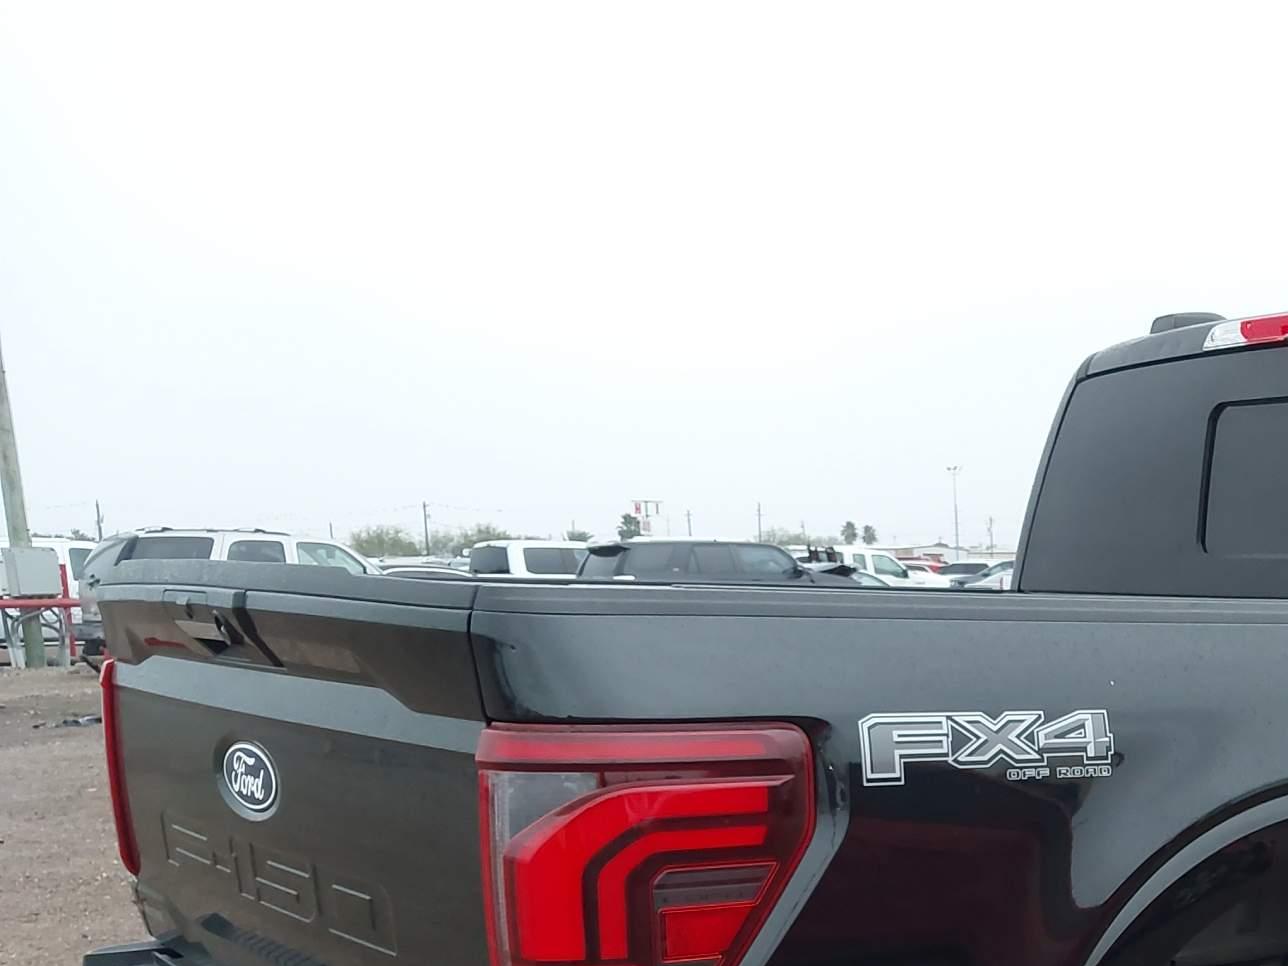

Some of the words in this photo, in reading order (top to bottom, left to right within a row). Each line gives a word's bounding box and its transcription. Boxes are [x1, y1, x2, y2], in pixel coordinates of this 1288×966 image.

[231, 750, 265, 801] Ford
[858, 709, 1115, 787] FX4
[1006, 767, 1050, 781] OFF
[1056, 766, 1113, 779] ROAD
[160, 809, 399, 958] F-150
